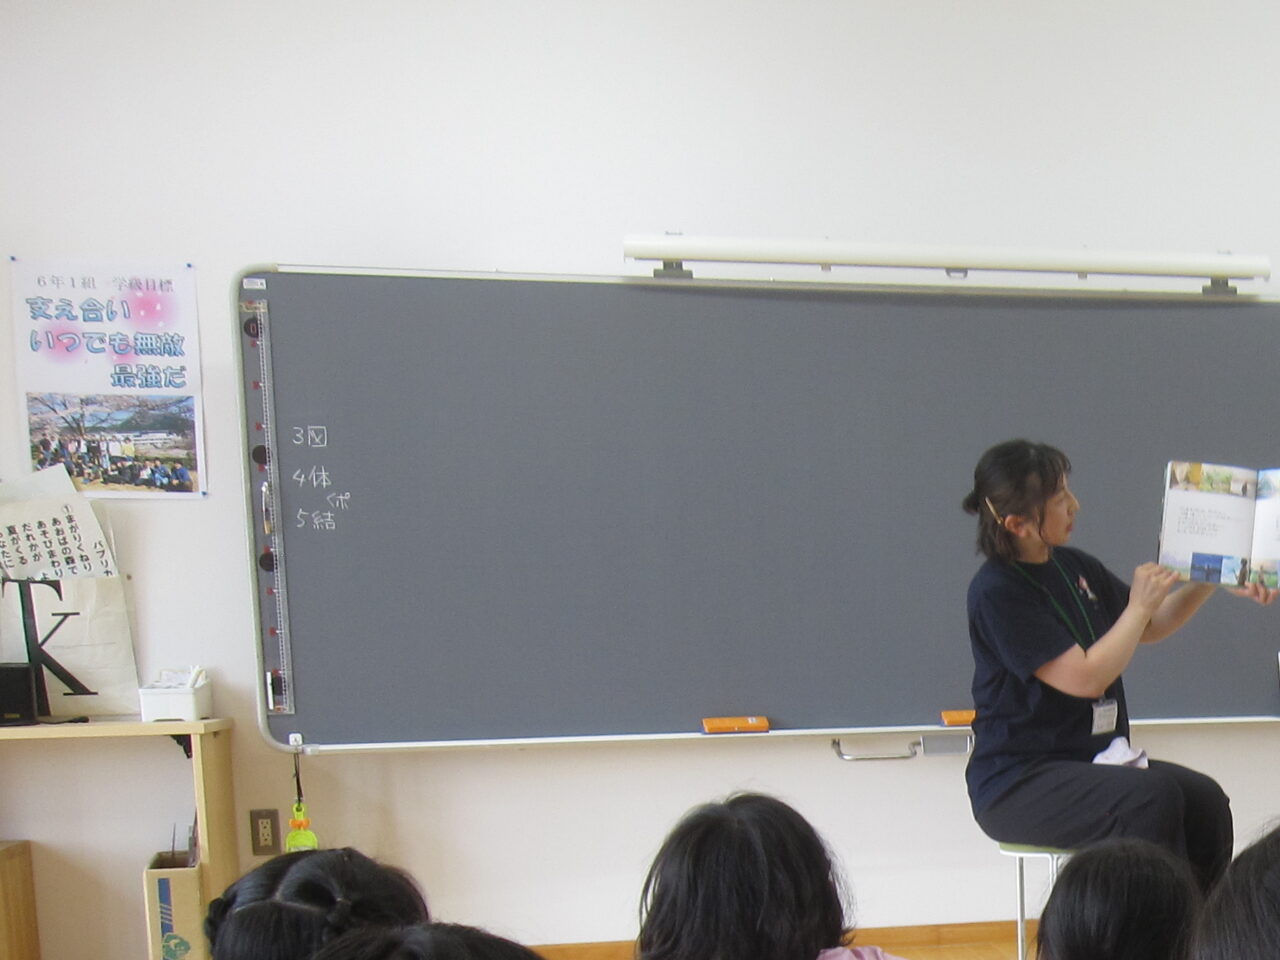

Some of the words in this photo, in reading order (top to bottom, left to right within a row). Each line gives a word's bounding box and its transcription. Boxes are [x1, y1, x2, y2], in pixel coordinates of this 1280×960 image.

[25, 296, 132, 323] 支え合い
[29, 330, 186, 357] いつでも無敵
[110, 363, 188, 389] 最強だ
